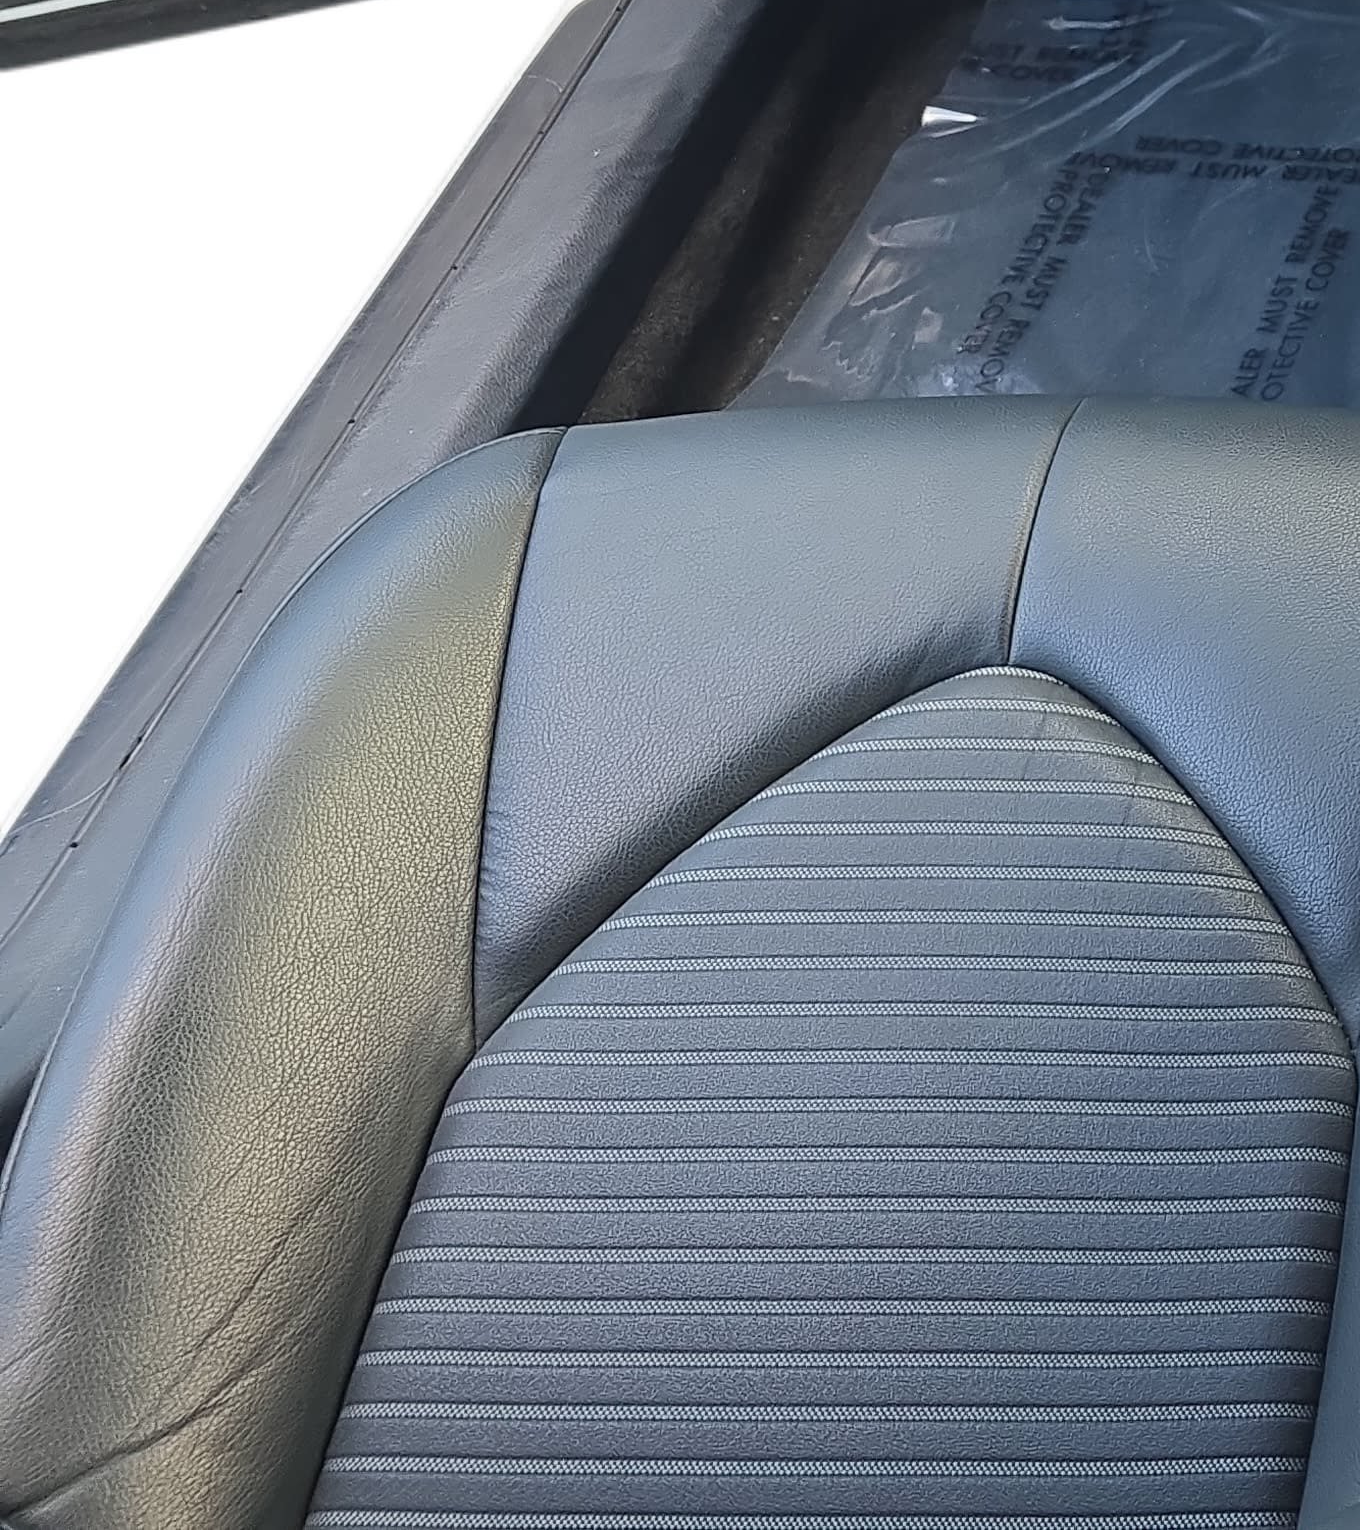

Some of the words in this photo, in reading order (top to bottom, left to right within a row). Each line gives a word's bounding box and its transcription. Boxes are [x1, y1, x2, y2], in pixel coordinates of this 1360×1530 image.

[1135, 134, 1222, 156] COVER
[1189, 161, 1267, 182] MUST
[1022, 257, 1069, 312] MUST
[1230, 347, 1267, 398] ALER
[1256, 275, 1299, 335] MUST
[1284, 183, 1340, 265] REMOVE
[1261, 299, 1320, 402] OTECTIVE
[1305, 228, 1352, 292] COVER
[976, 317, 1031, 395] REMOV
